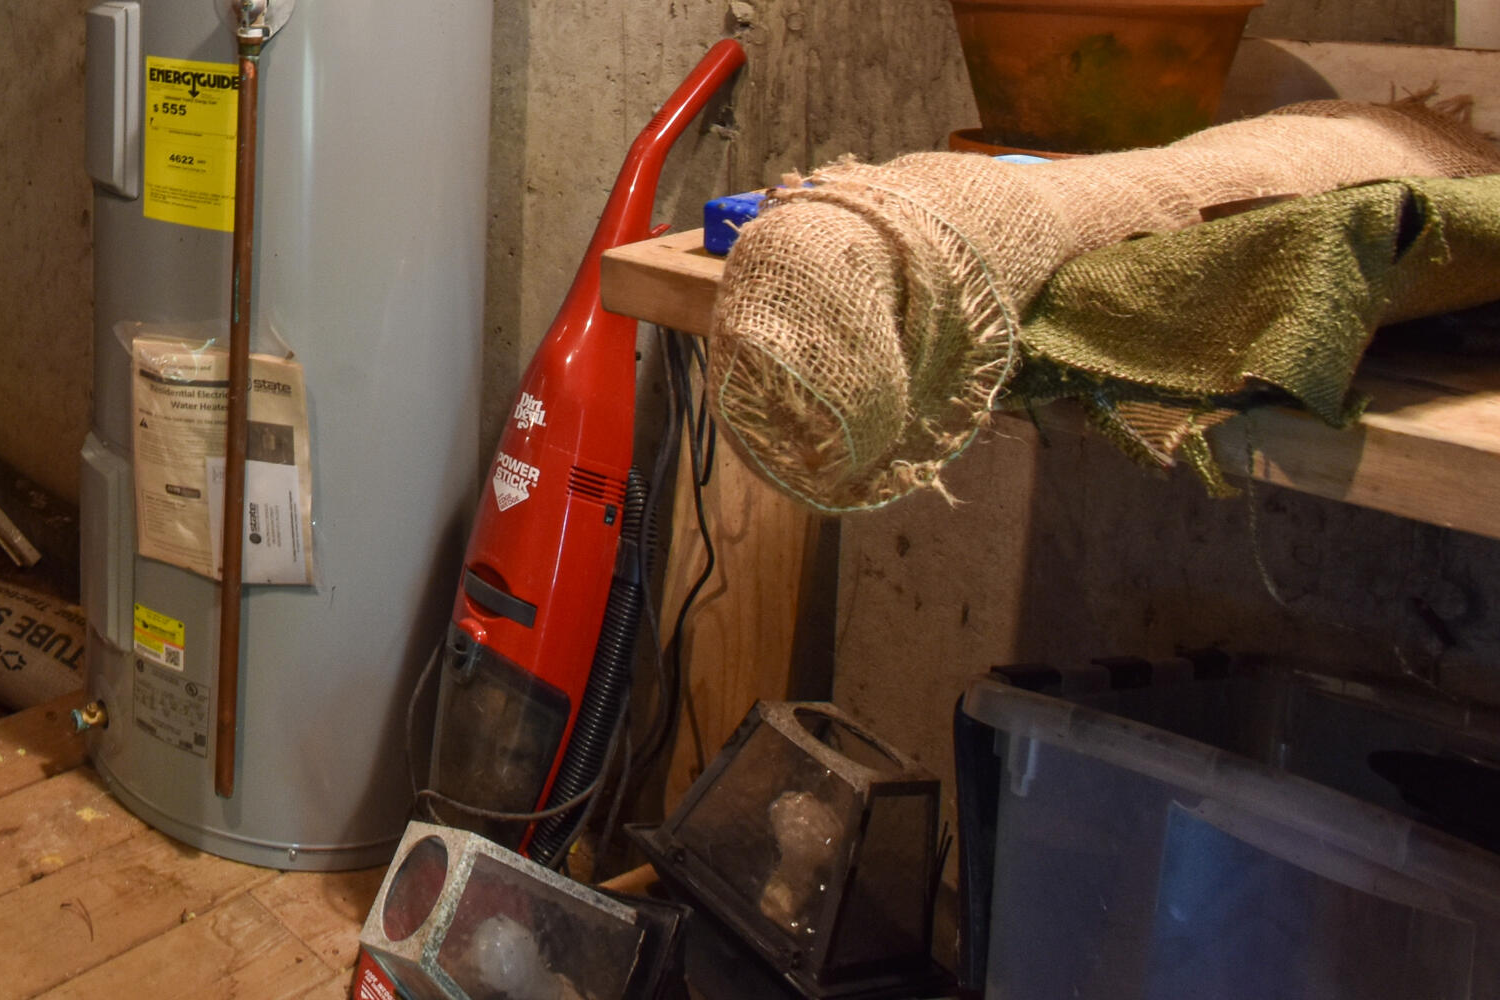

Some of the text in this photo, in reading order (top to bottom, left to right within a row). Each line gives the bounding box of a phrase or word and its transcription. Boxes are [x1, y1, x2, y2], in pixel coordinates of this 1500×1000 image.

[149, 67, 241, 96] ENERGYGUIDE
[162, 103, 187, 116] 555
[169, 153, 194, 165] 4622
[197, 390, 228, 399] Electric
[253, 379, 292, 393] state
[171, 401, 198, 410] Water
[520, 392, 543, 410] Dirt
[514, 404, 546, 428] Devil
[497, 451, 540, 482] POWER
[495, 466, 531, 493] STICK
[249, 502, 257, 532] state
[7, 615, 85, 670] TUBE
